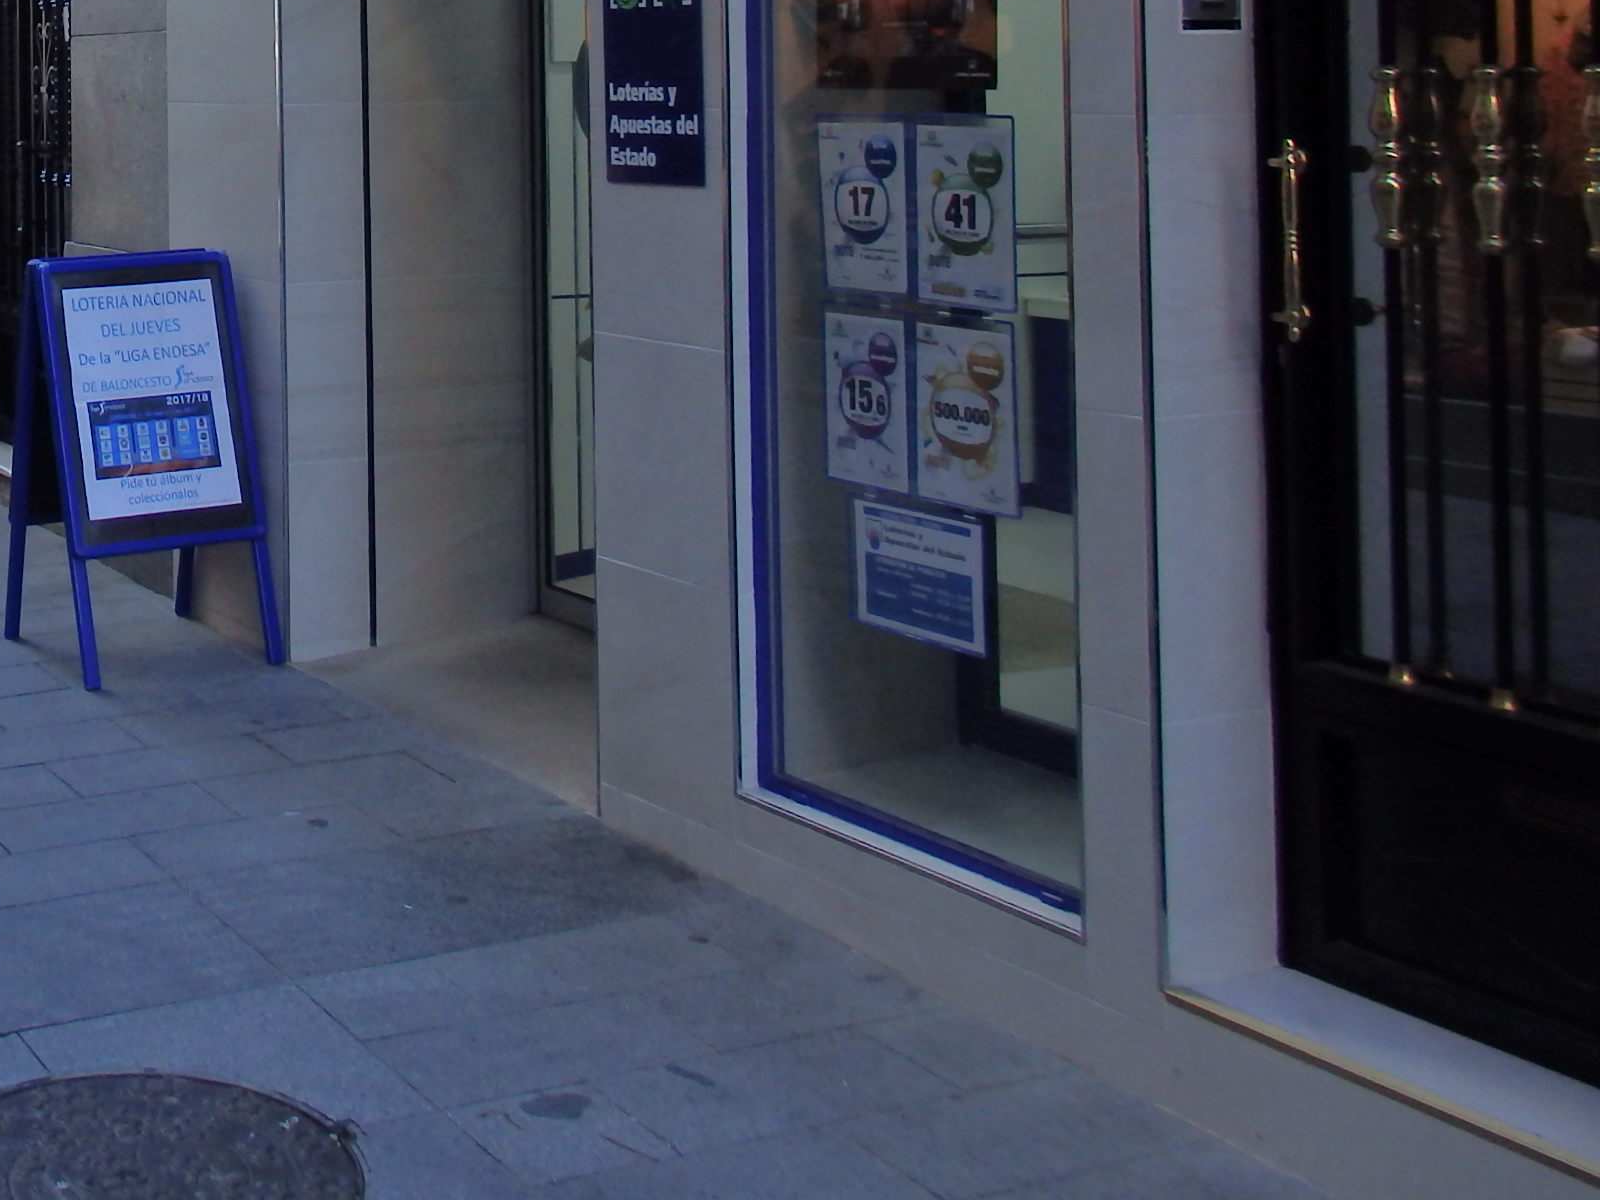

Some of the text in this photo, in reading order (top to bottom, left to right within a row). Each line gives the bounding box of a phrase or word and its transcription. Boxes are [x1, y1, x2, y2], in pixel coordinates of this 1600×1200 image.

[609, 81, 677, 107] Loterías y
[610, 114, 699, 142] Apuestas del
[610, 146, 657, 168] Estado
[848, 186, 875, 216] 17
[944, 193, 976, 230] 41
[71, 289, 207, 312] LOTERIA NACIONAL
[100, 318, 181, 338] DEL JUEVES
[78, 353, 96, 367] De
[99, 351, 111, 365] la
[82, 374, 172, 394] DE BALONCESTO
[846, 377, 873, 414] 15
[166, 392, 209, 406] 2017/18
[934, 400, 990, 426] 500.000
